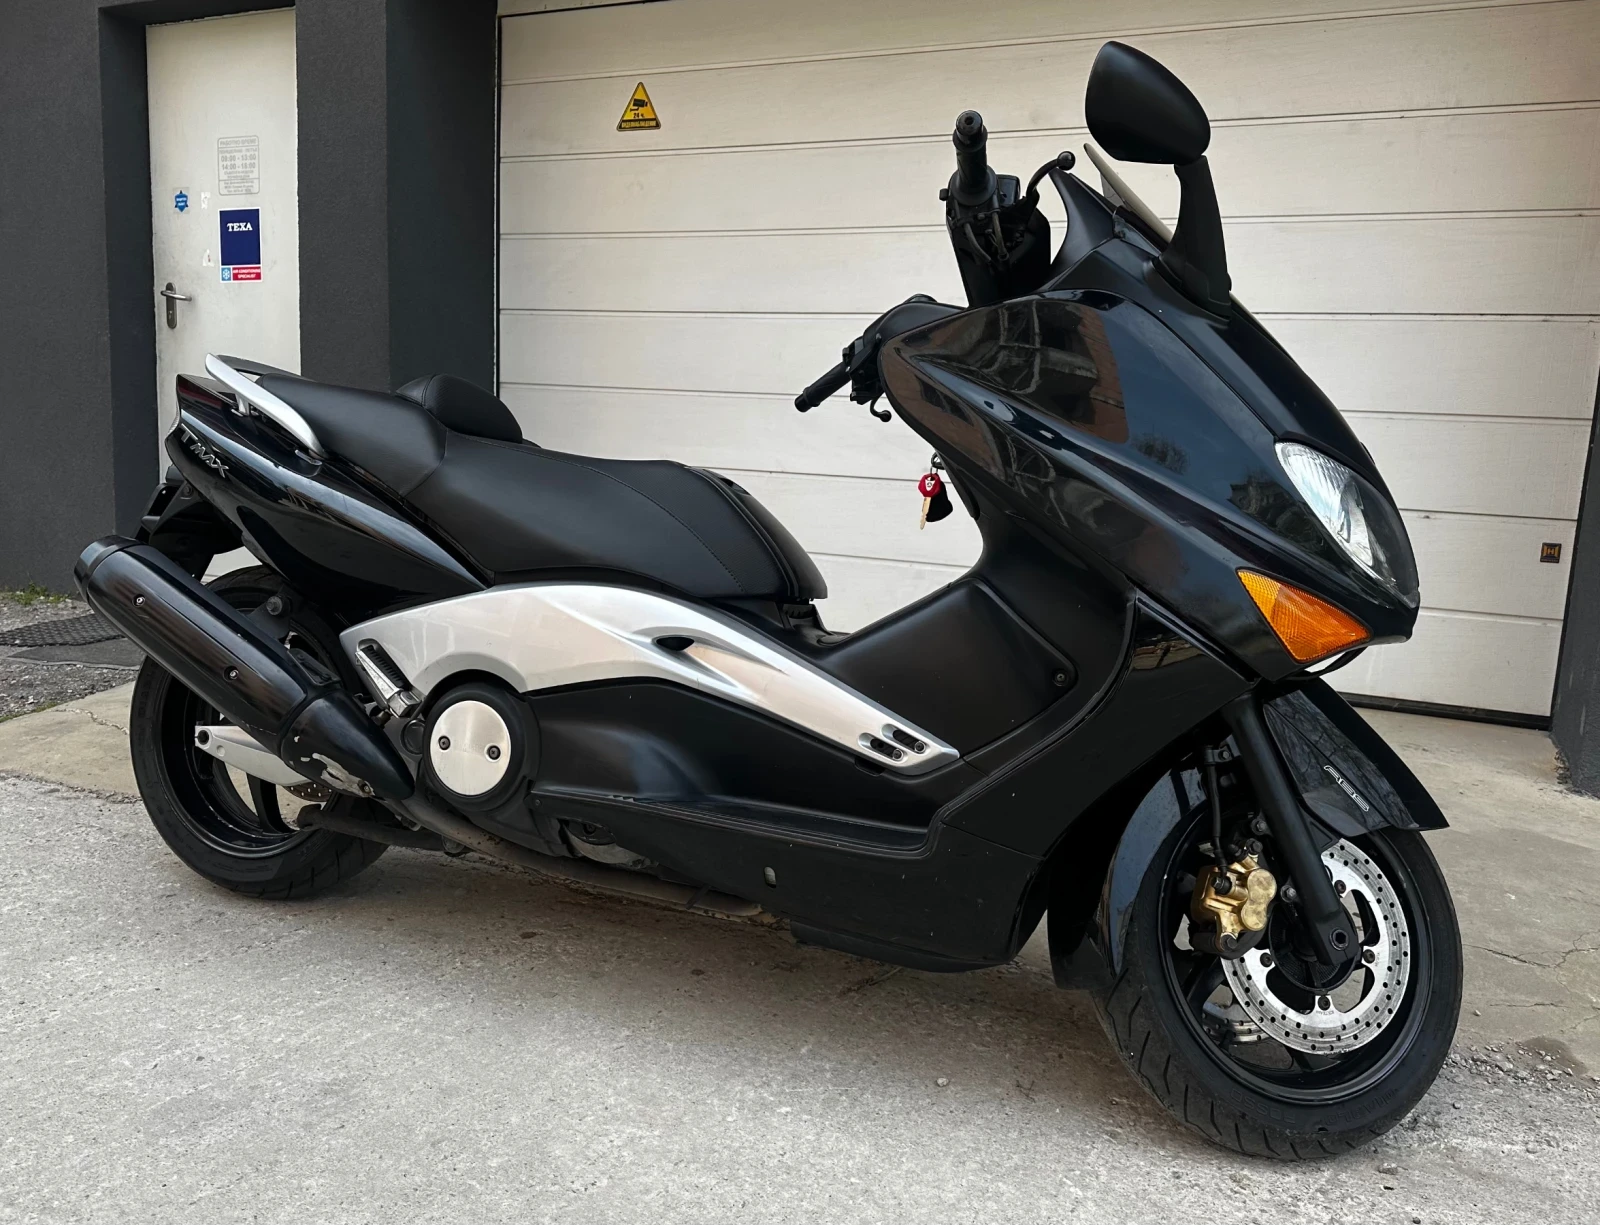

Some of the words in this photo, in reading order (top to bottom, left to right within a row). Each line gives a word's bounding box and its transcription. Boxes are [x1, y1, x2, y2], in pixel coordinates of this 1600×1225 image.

[222, 162, 236, 170] 14:00
[226, 222, 253, 232] TEXA
[1323, 764, 1370, 812] ABS
